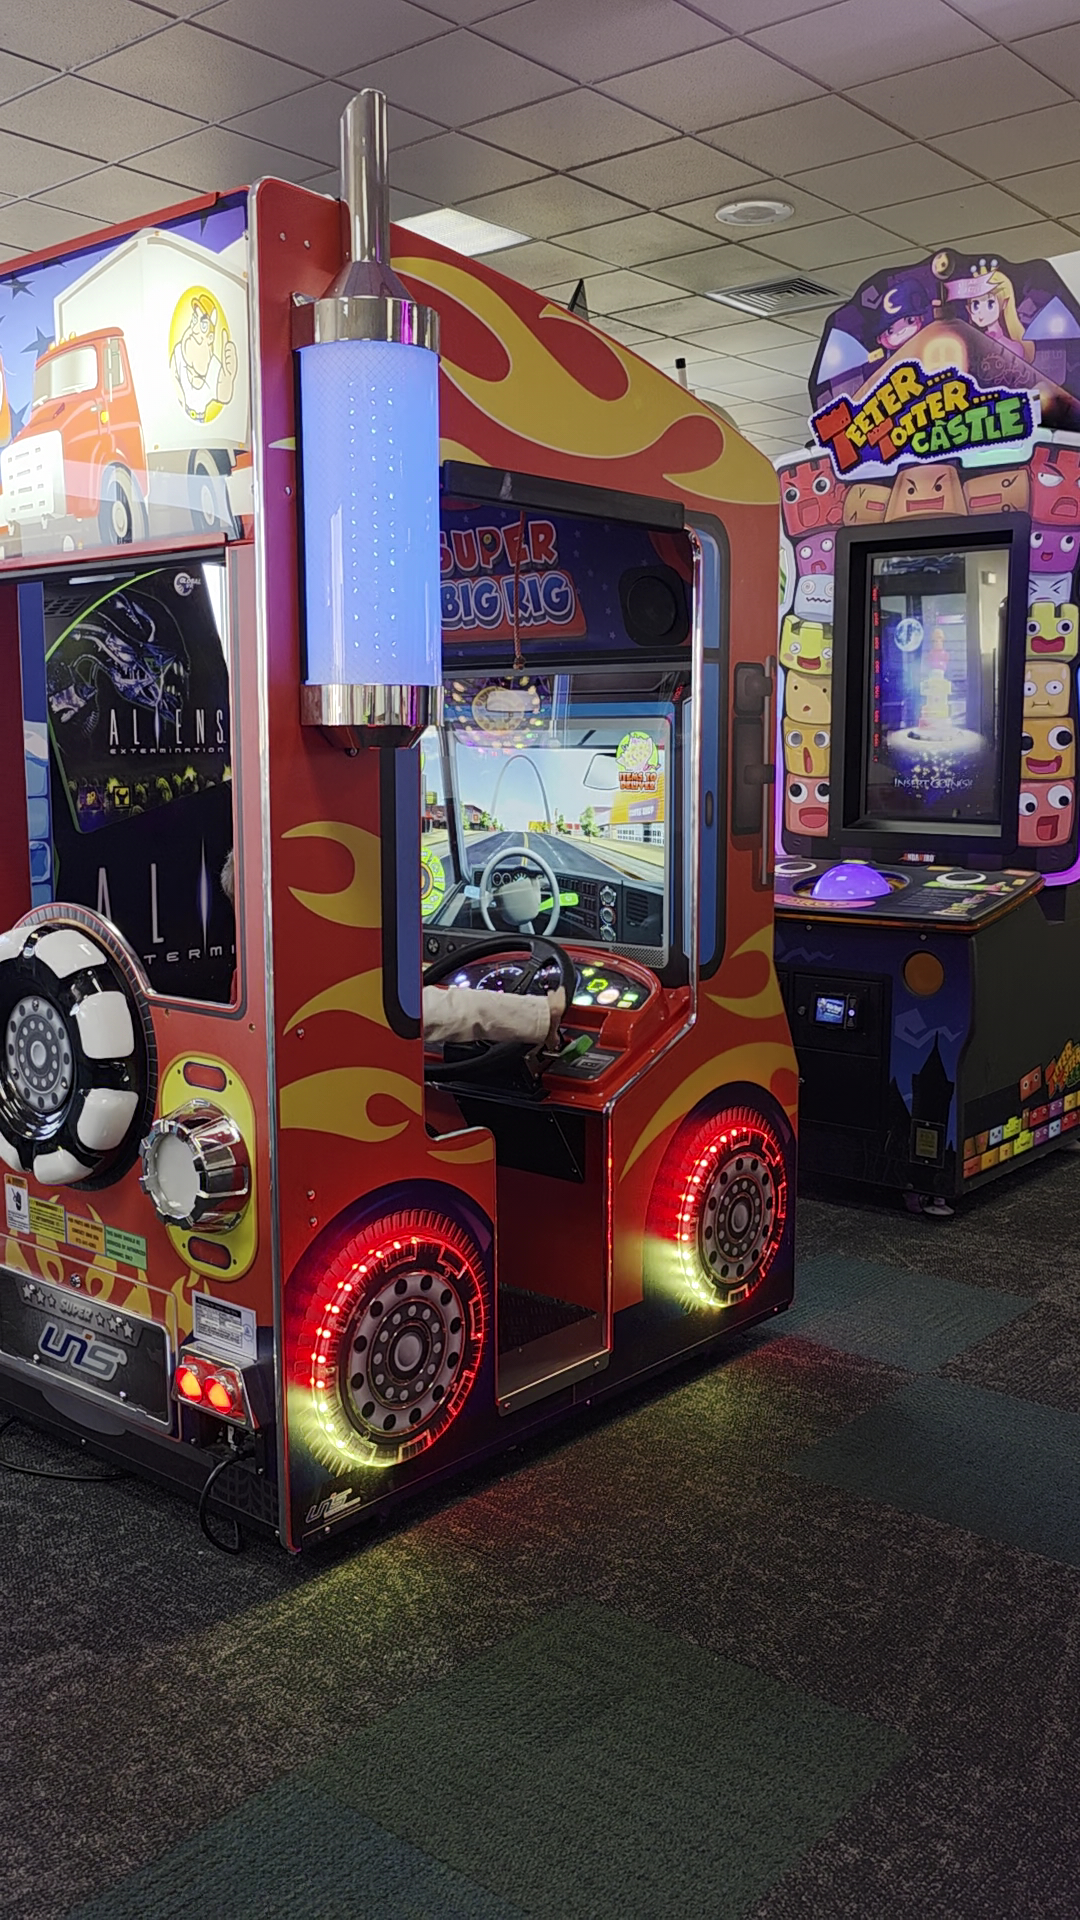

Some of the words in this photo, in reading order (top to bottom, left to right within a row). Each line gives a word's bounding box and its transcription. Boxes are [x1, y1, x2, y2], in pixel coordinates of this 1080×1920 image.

[911, 396, 1024, 453] CASTLE
[440, 520, 558, 573] SUPER
[440, 576, 503, 629] BIG
[501, 571, 575, 627] RIG
[110, 708, 225, 747] ALIENS
[110, 747, 224, 755] EXTERMINATION
[60, 1298, 95, 1321] SUPER
